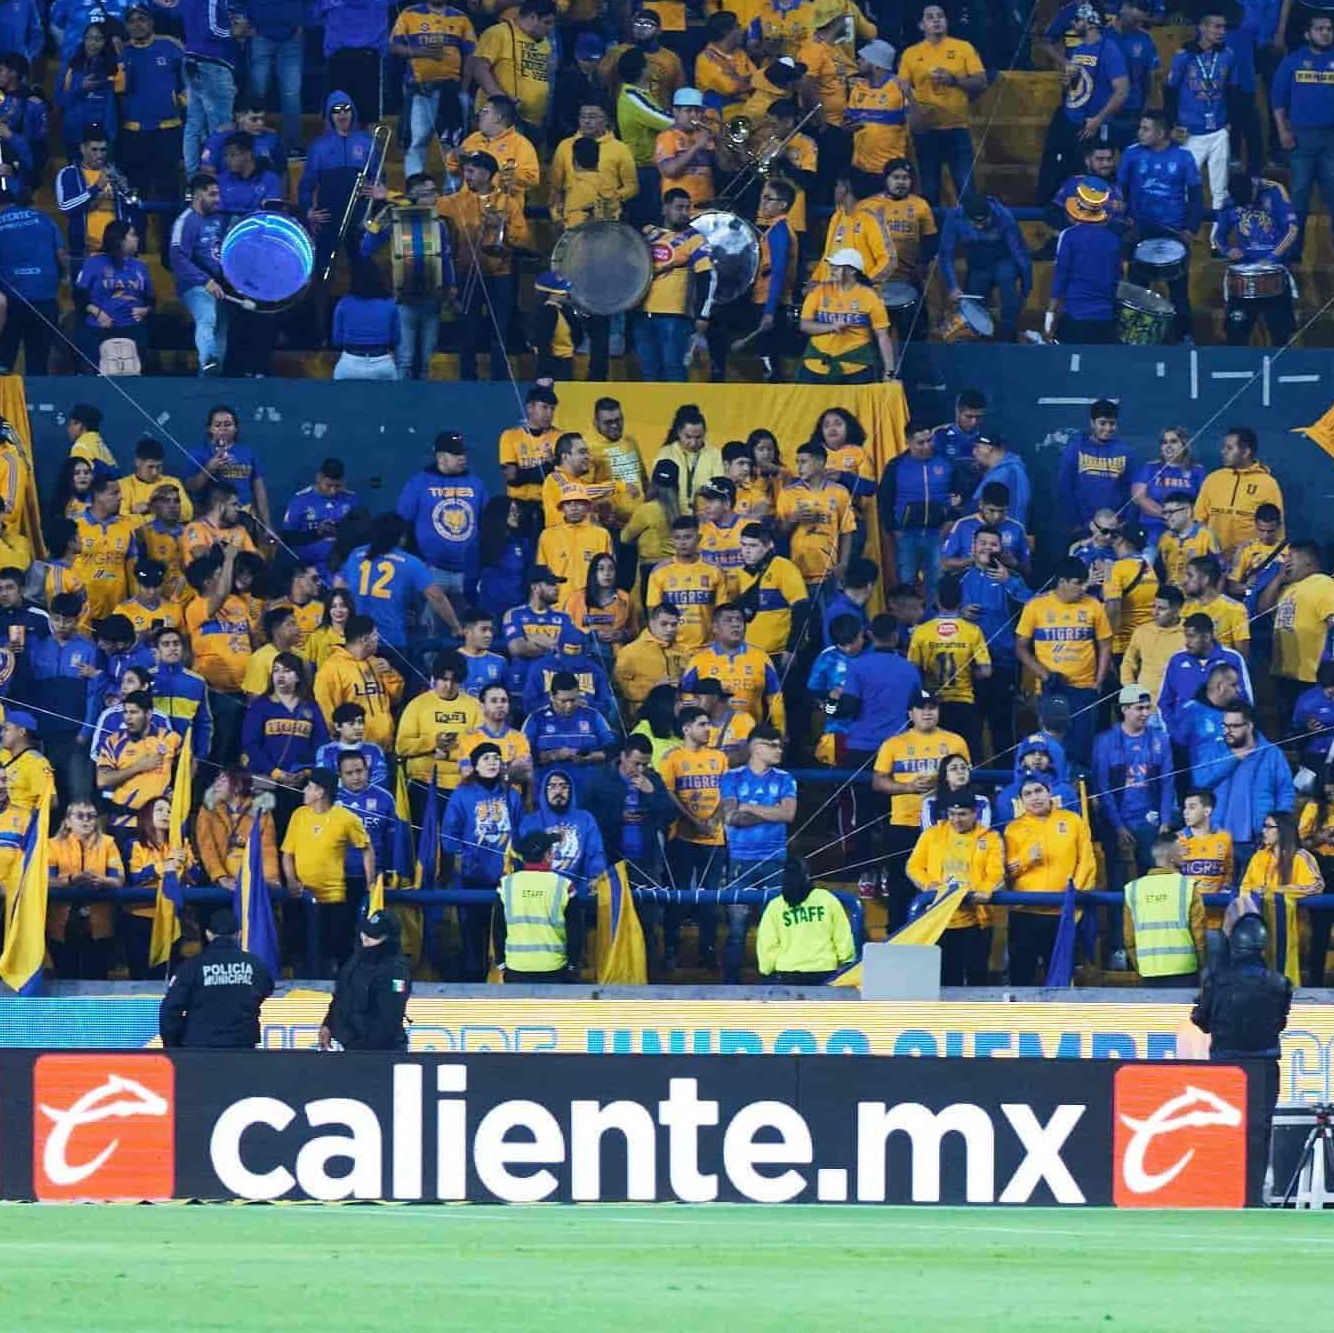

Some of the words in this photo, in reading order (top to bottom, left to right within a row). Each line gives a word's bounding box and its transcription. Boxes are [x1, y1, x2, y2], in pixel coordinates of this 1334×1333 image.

[428, 486, 474, 498] TIGRES
[358, 561, 395, 598] 12
[667, 592, 710, 605] TIGRES
[1043, 628, 1088, 640] TIGRES
[903, 759, 939, 772] TIGR
[683, 776, 719, 788] TIGRE
[782, 906, 825, 927] STAFF
[203, 961, 253, 975] POLICÍA
[203, 973, 253, 986] MUNICIPAL
[209, 1063, 1087, 1204] caliente.mx
